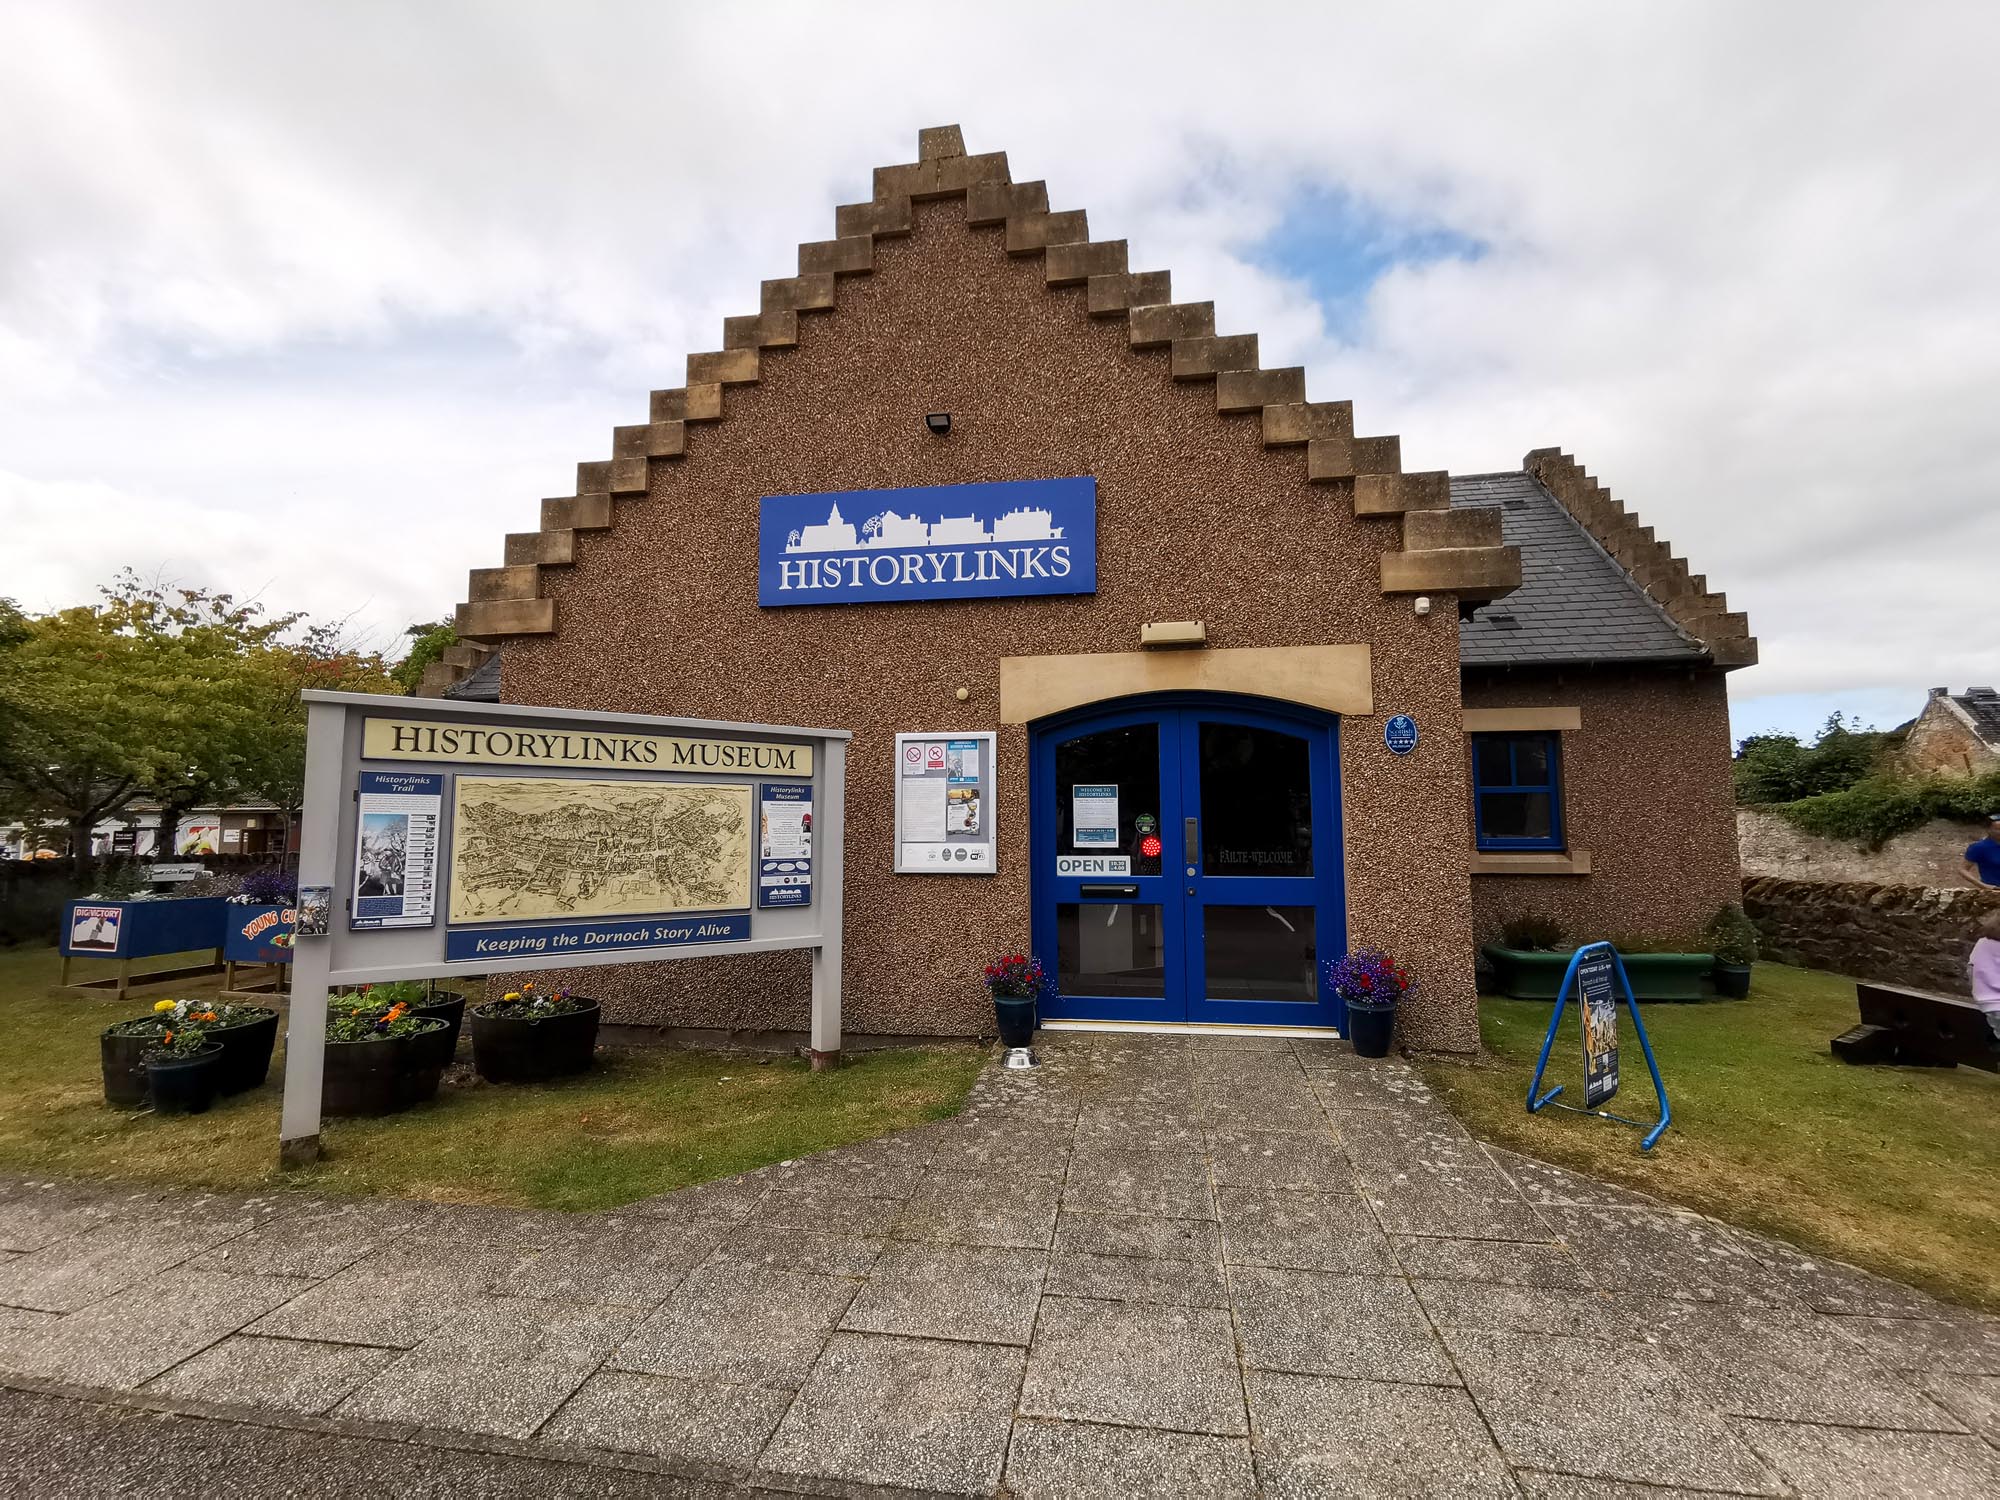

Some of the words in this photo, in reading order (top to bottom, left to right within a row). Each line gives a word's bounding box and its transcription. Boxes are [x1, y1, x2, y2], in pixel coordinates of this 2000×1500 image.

[778, 546, 1072, 591] HISTORYLINKS
[391, 725, 658, 764] HISTORYLINKS
[671, 742, 797, 770] MUSEUM
[375, 775, 431, 786] Historylinks
[391, 784, 415, 792] Trail
[770, 786, 805, 795] Historylinks
[1058, 859, 1104, 872] OPEN
[90, 909, 120, 918] VICTORY
[242, 911, 278, 940] YOUNG
[476, 936, 548, 953] Keeping
[552, 933, 579, 947] the
[583, 928, 650, 945] Dornoch
[654, 927, 694, 941] Story
[696, 924, 732, 937] Alive
